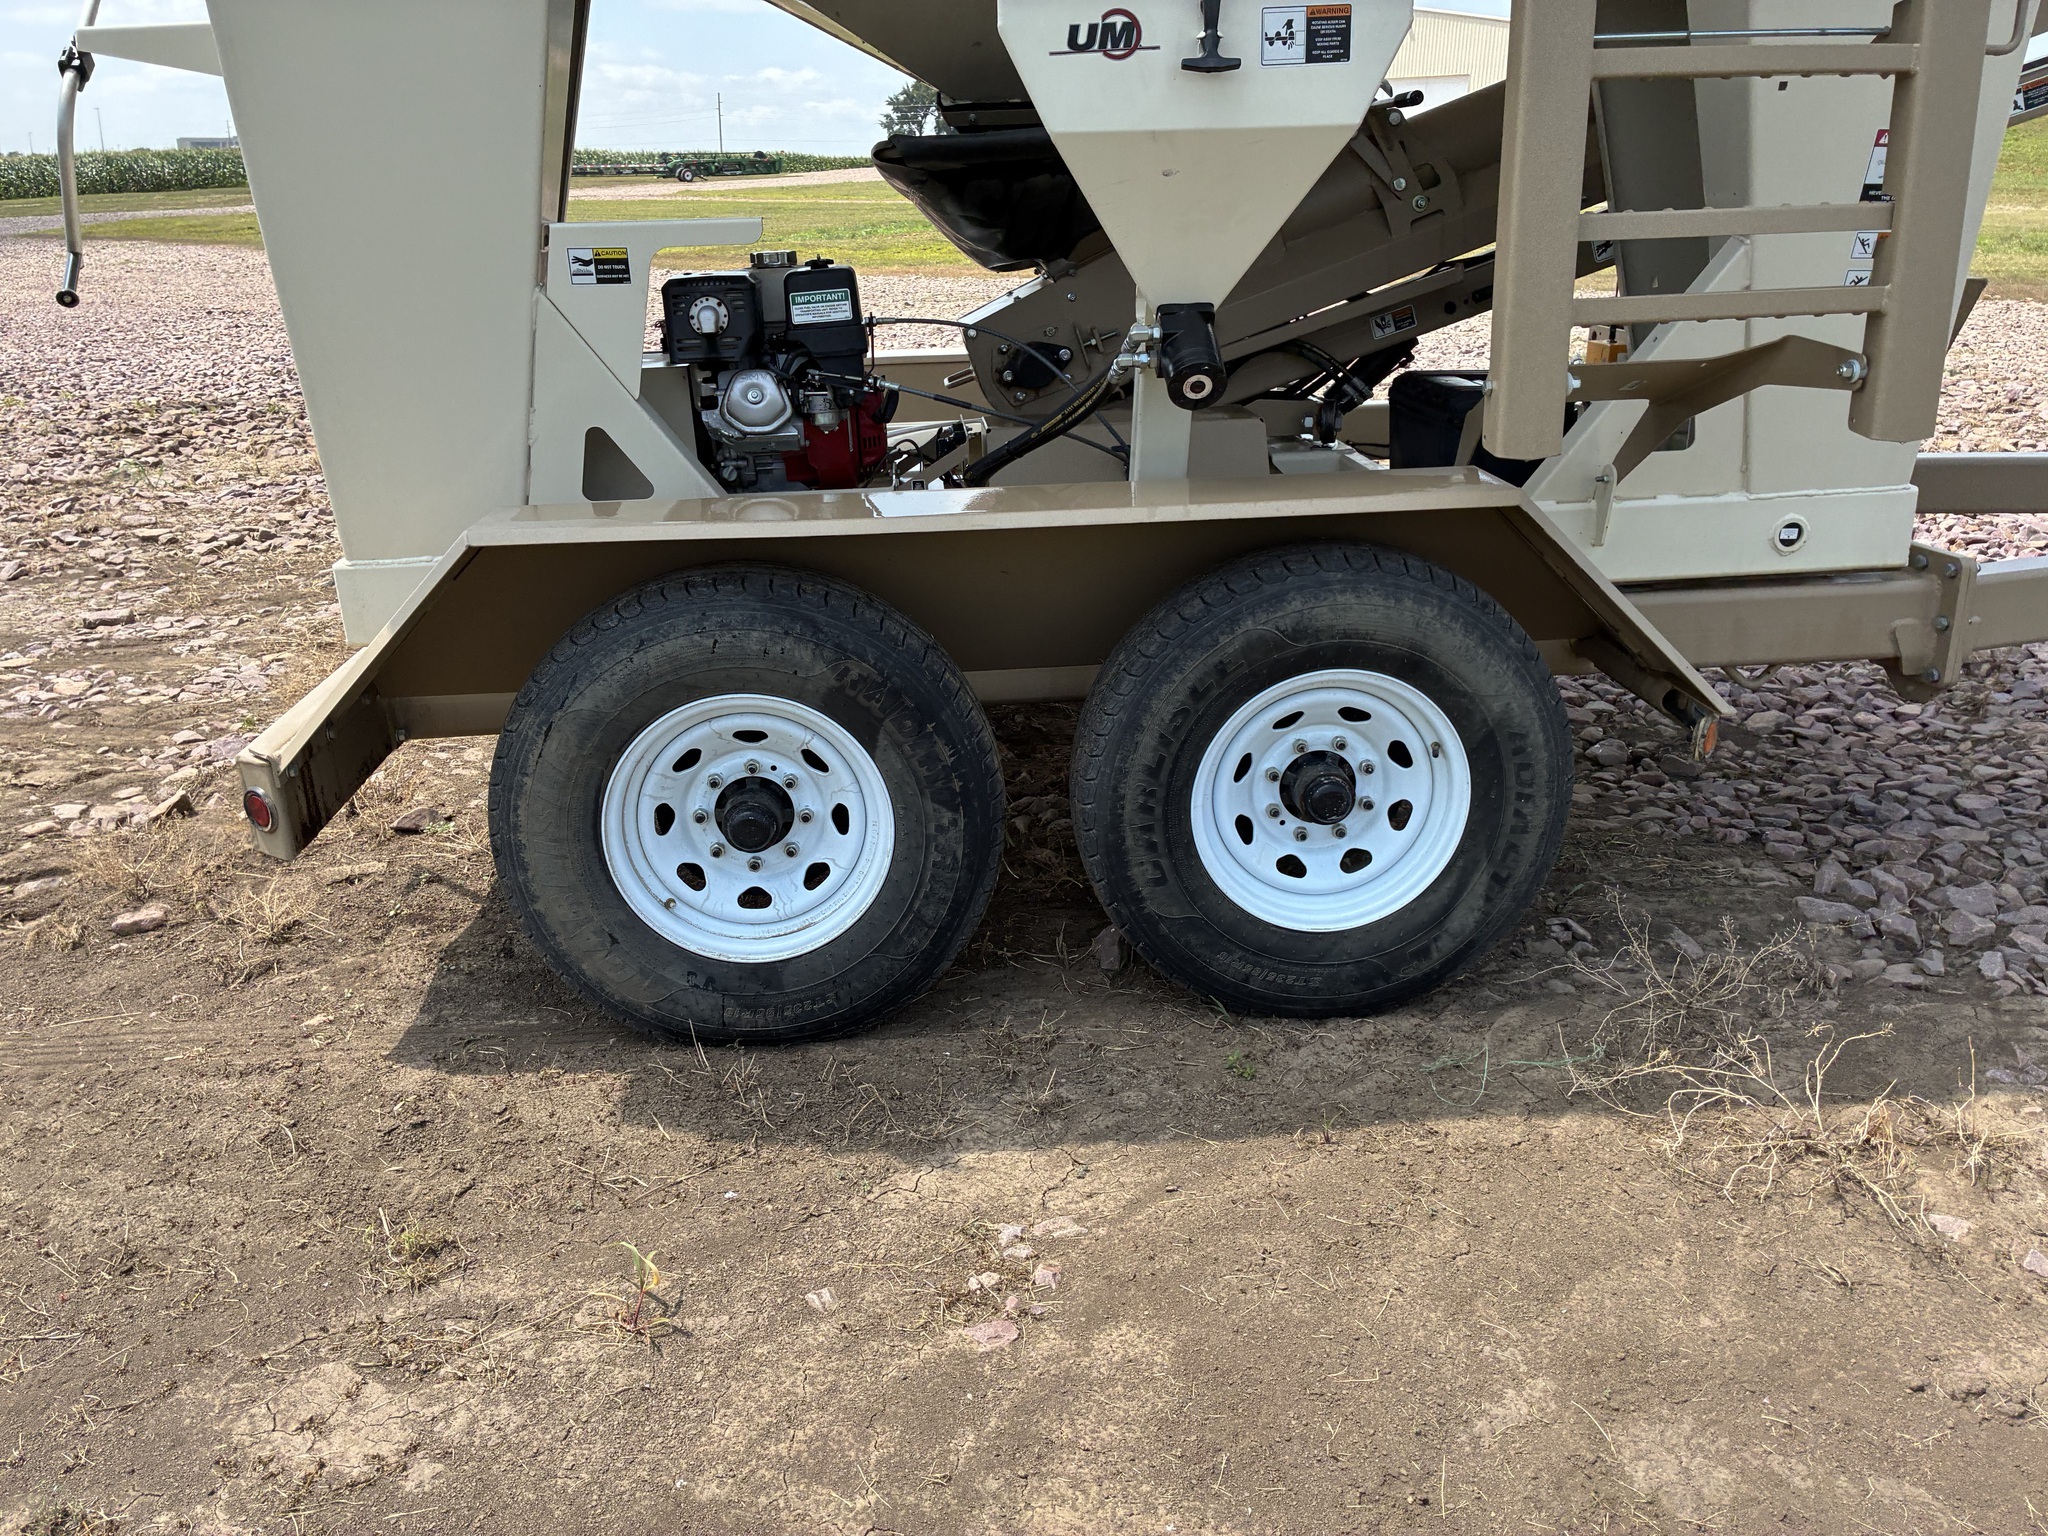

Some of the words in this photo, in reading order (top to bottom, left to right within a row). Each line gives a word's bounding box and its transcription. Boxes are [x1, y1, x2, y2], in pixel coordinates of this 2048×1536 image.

[1315, 7, 1349, 15] WARNING
[1067, 21, 1136, 51] UM
[795, 292, 845, 303] IMPORTANT!
[1126, 650, 1246, 888] CARLISLE
